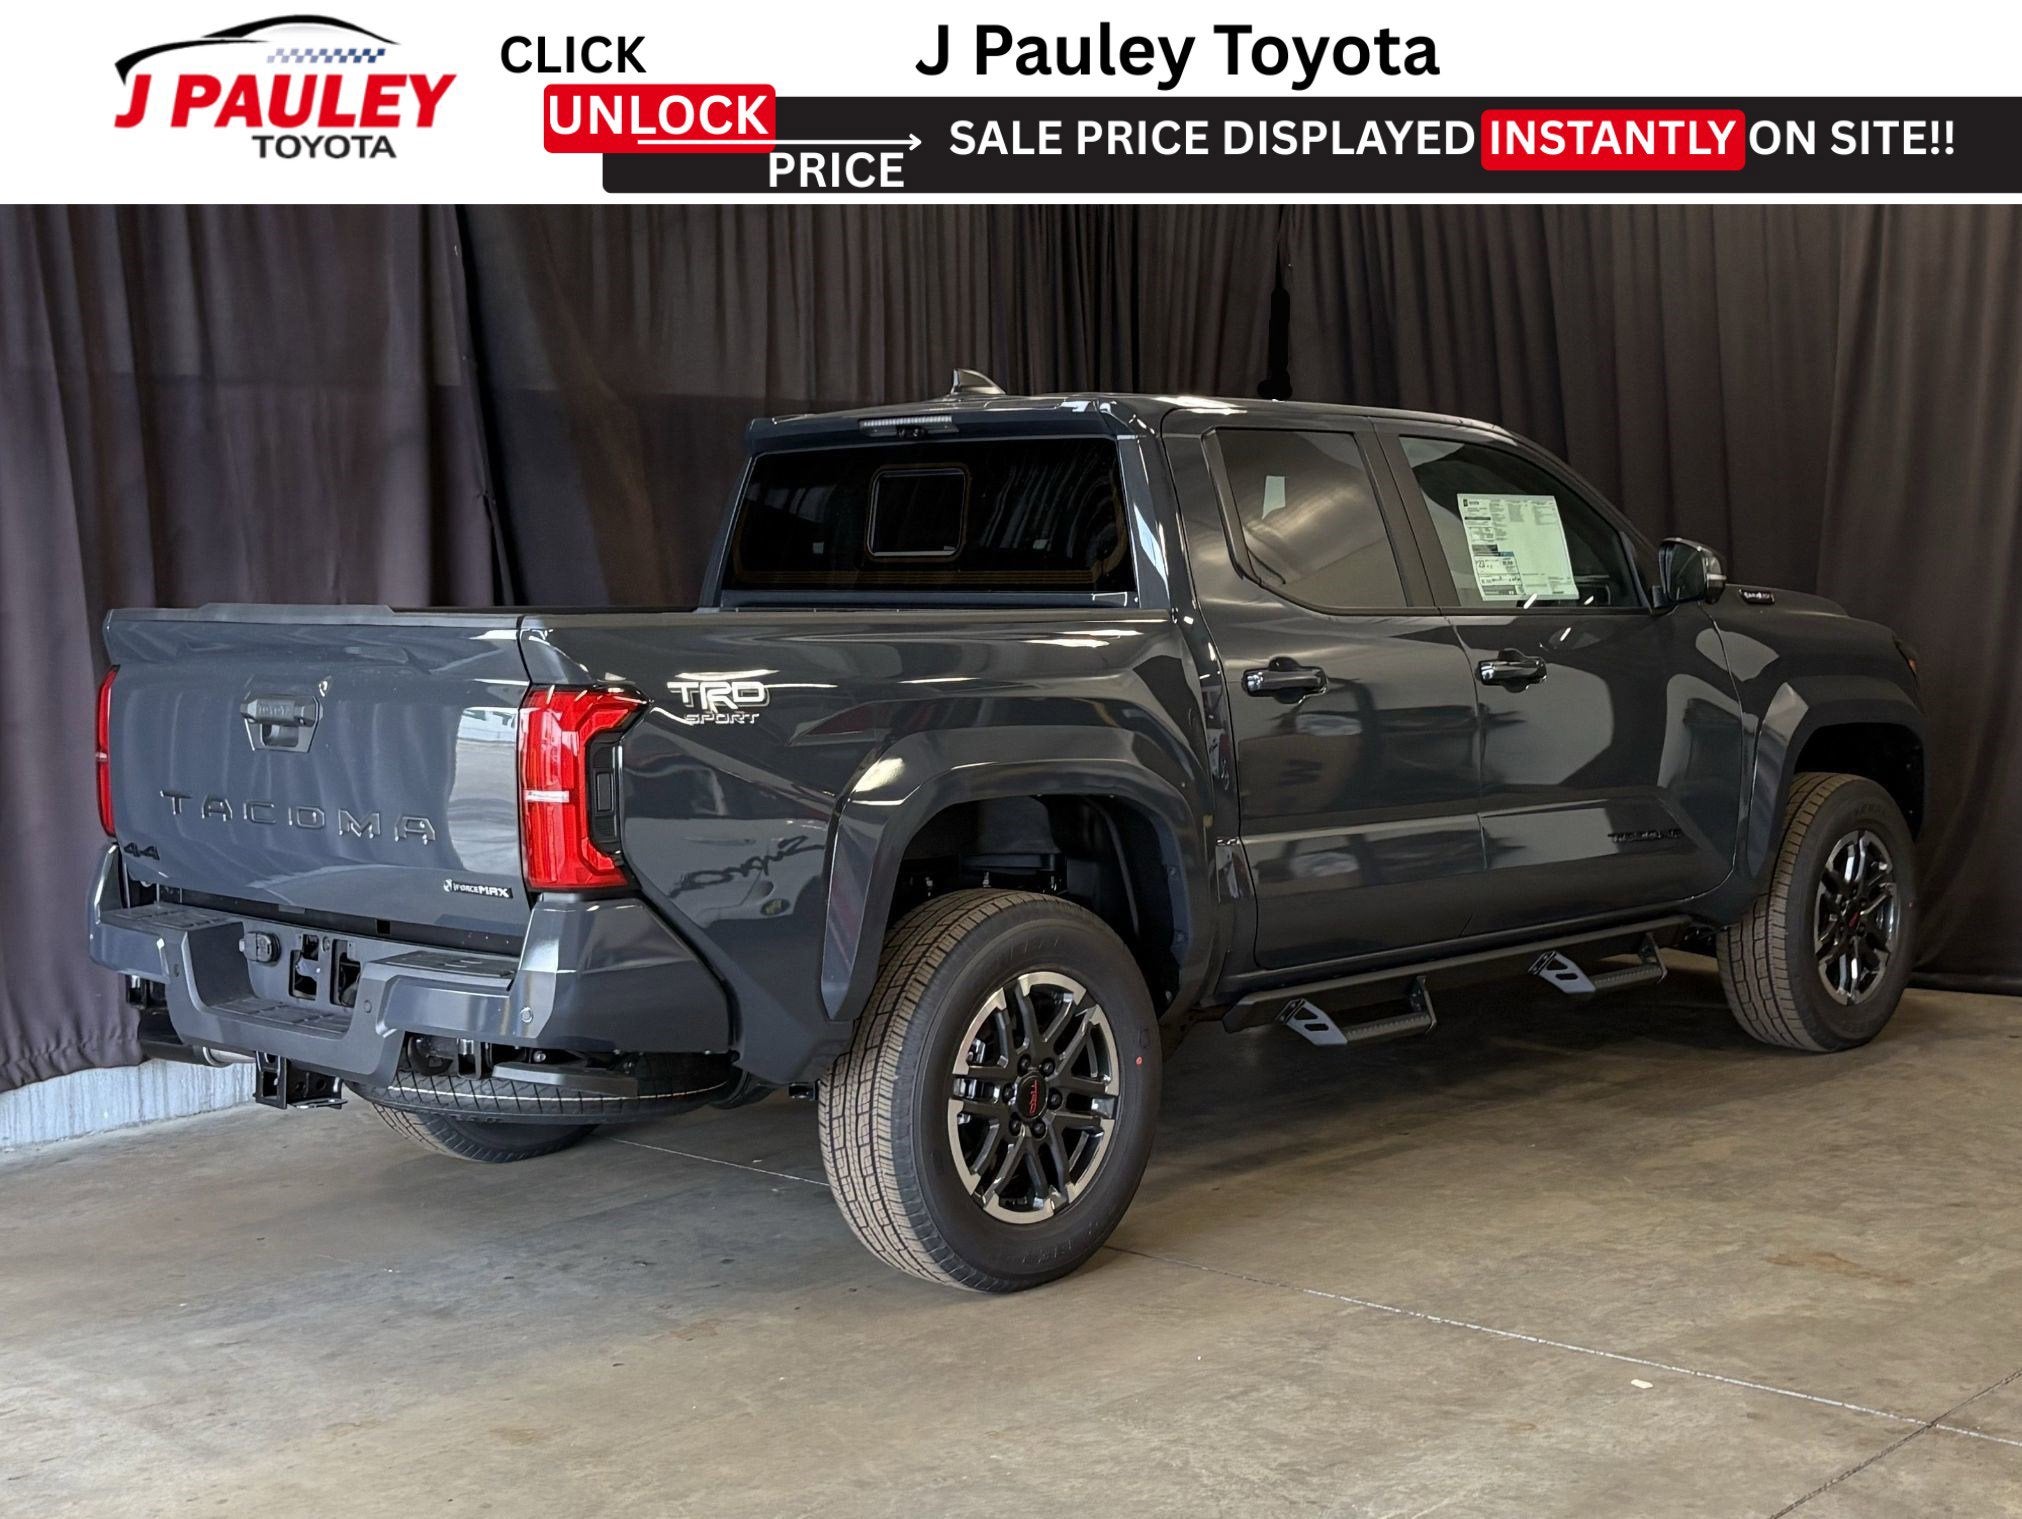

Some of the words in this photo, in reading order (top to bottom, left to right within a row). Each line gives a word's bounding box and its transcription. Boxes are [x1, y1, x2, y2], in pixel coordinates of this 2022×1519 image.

[667, 681, 770, 713] TRD
[685, 713, 760, 725] SPORT
[159, 789, 436, 845] TACOMA
